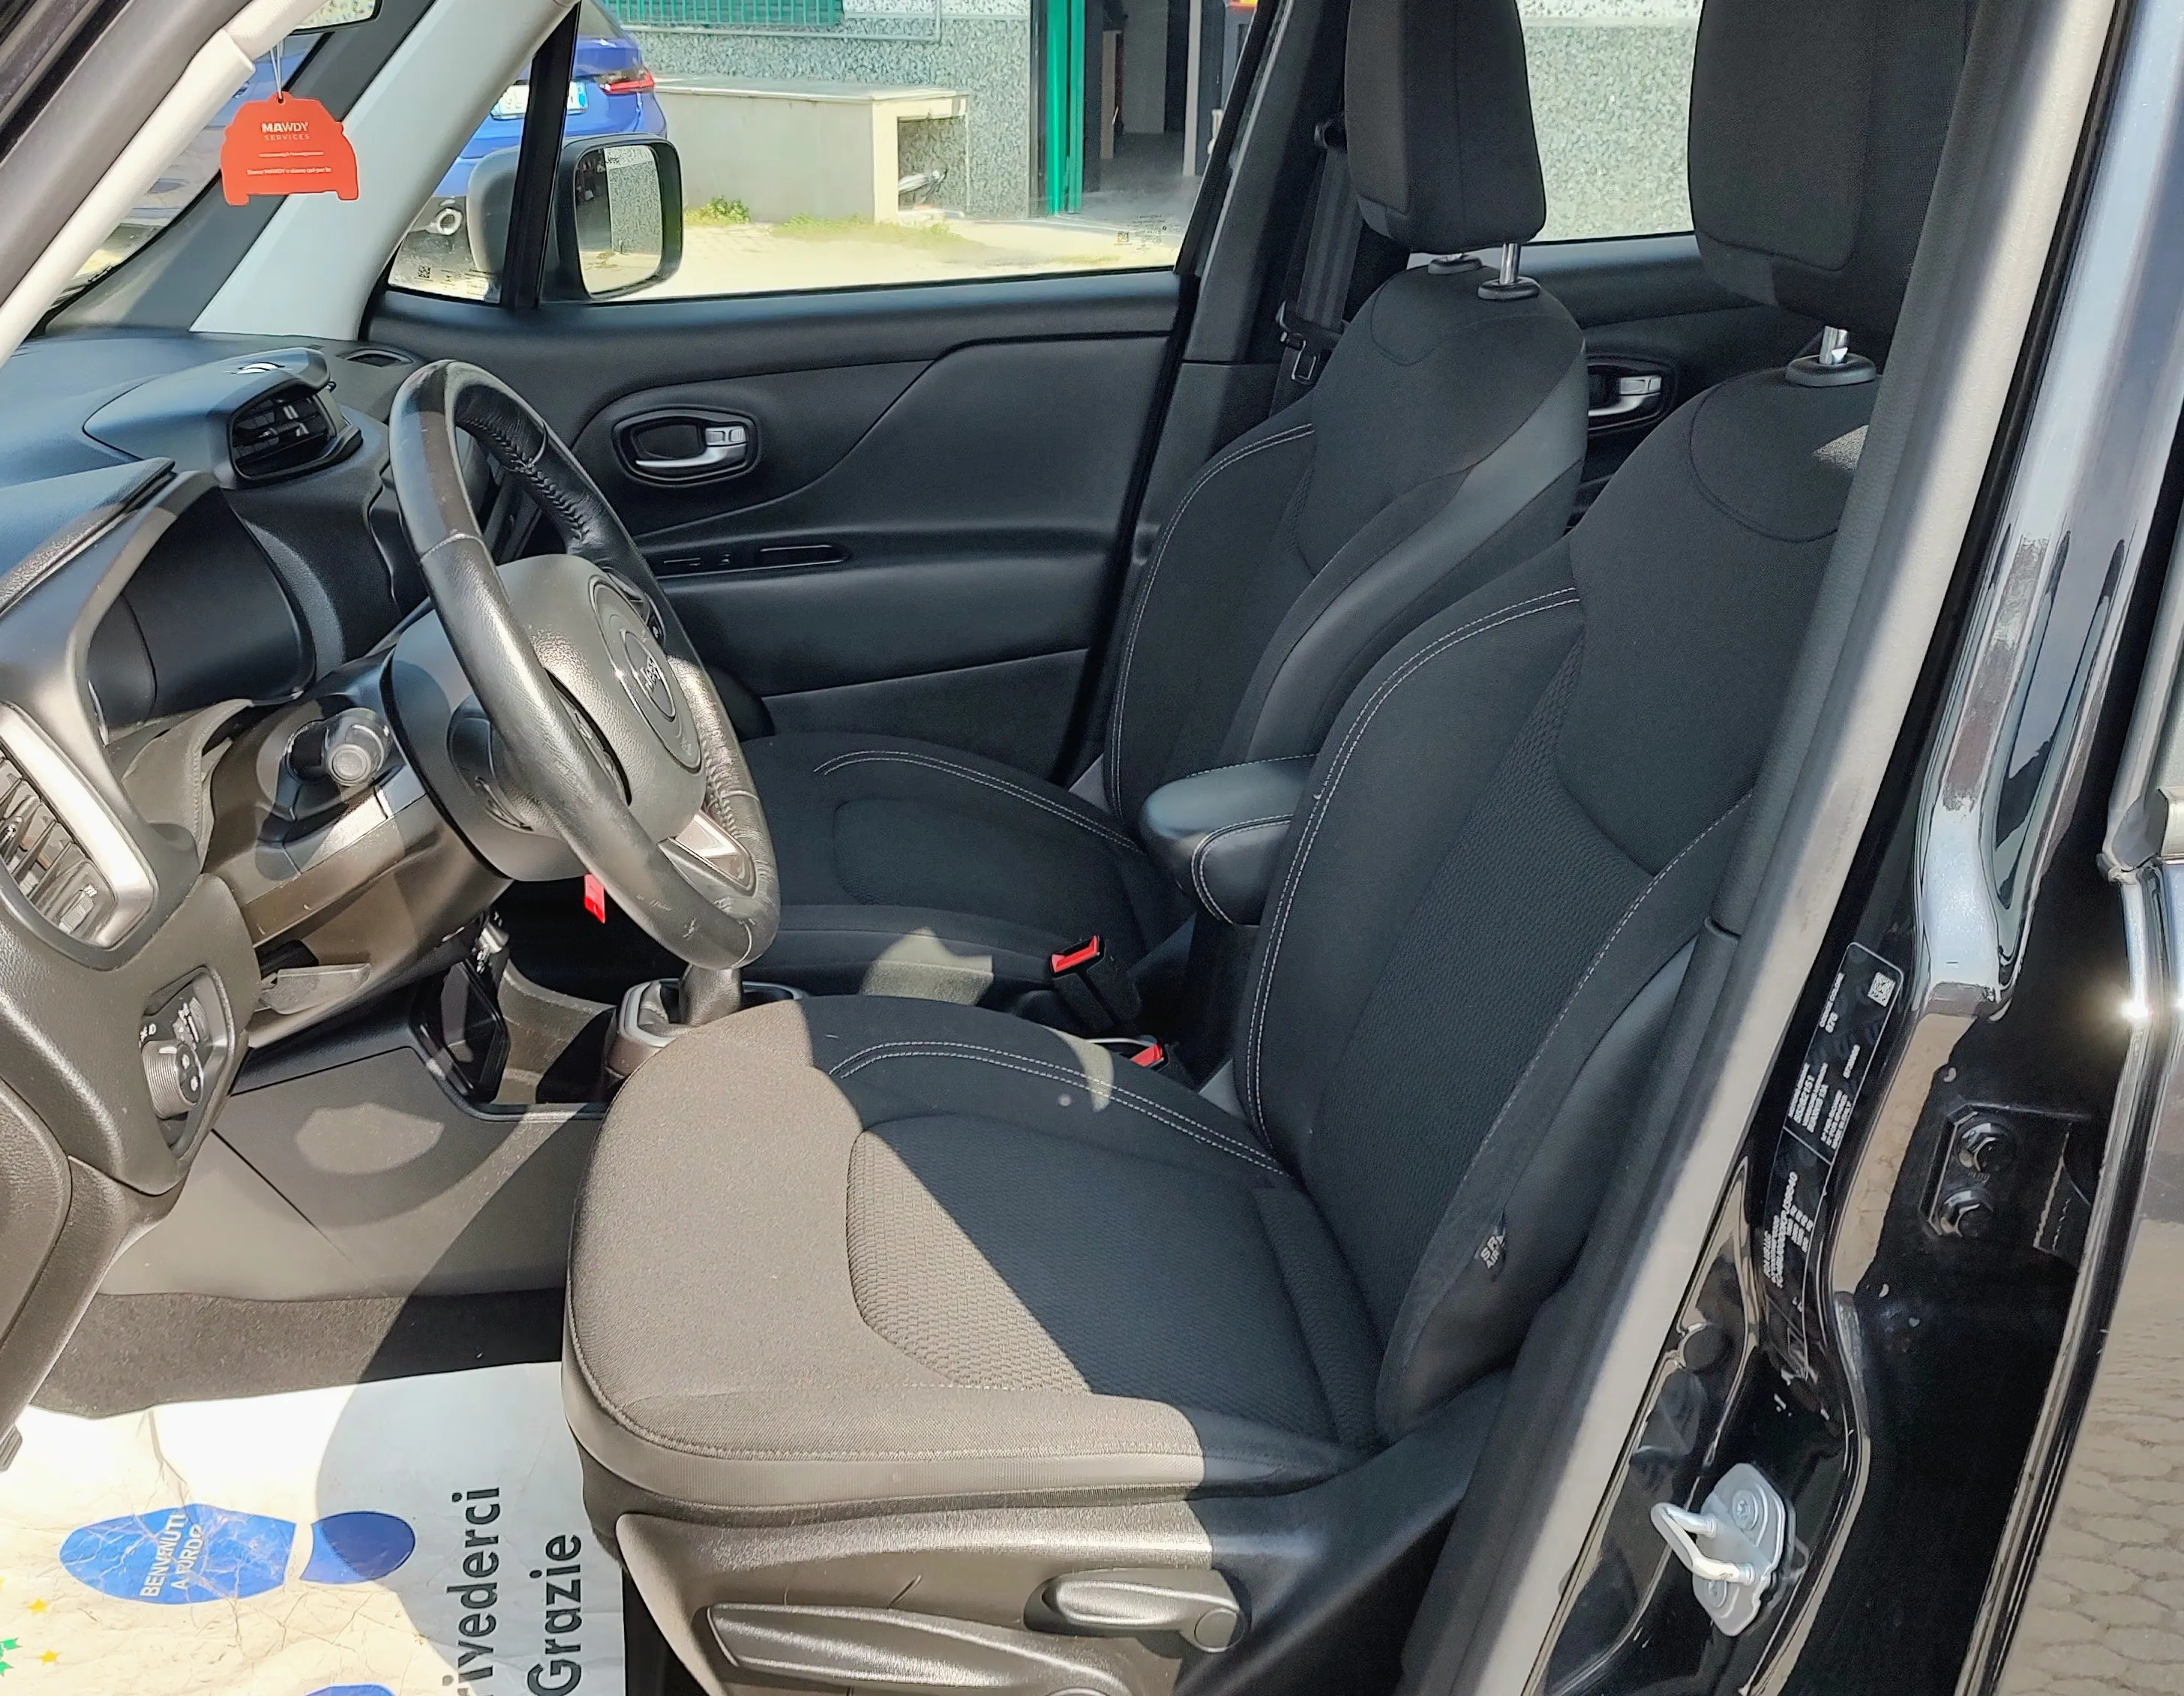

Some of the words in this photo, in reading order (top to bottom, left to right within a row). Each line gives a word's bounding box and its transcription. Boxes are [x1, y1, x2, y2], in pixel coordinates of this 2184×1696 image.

[262, 122, 309, 133] MAWDY
[140, 1513, 187, 1596] BENVENUTI
[527, 1535, 582, 1696] Grazie
